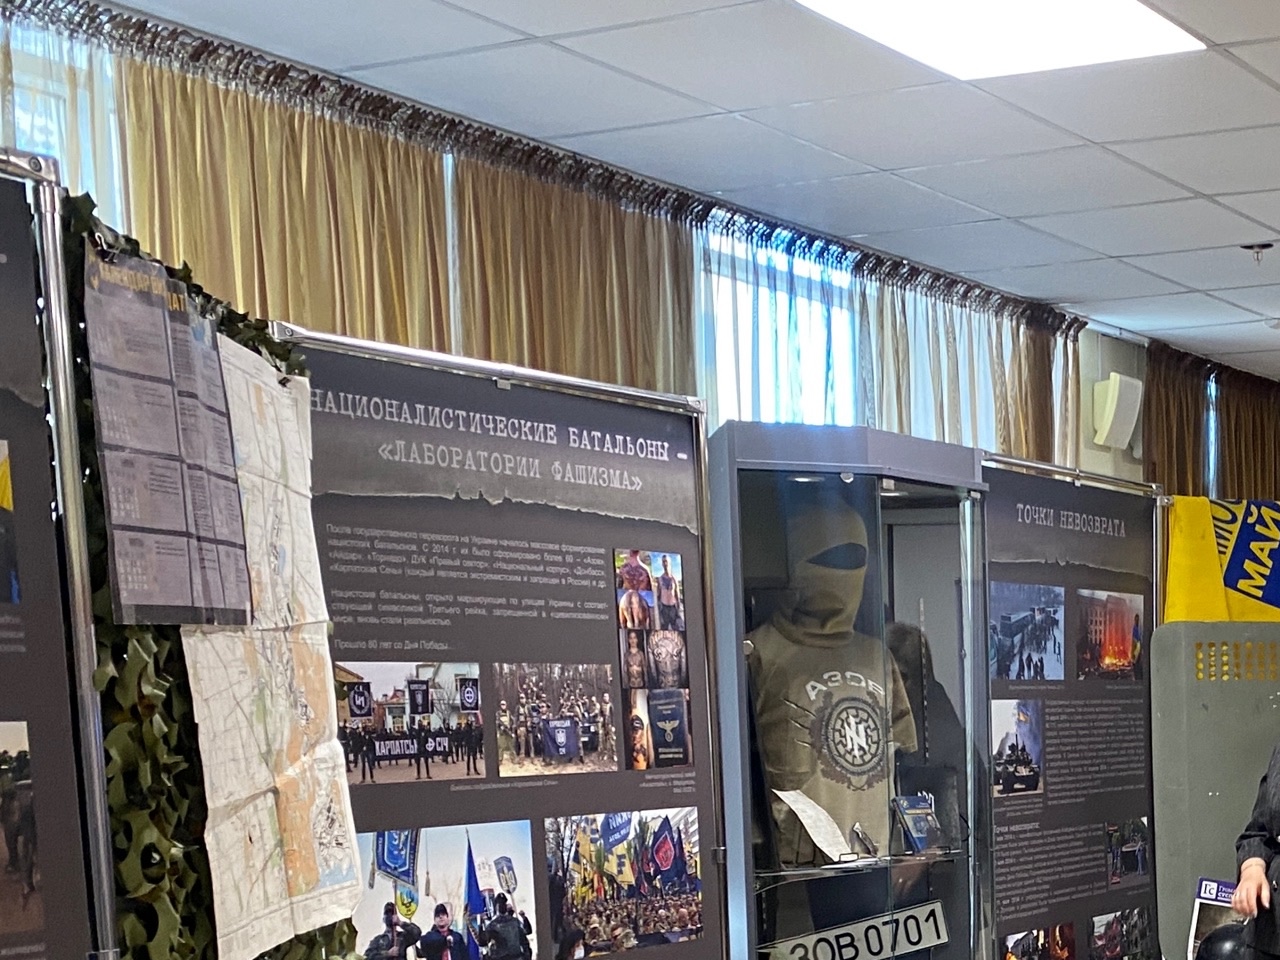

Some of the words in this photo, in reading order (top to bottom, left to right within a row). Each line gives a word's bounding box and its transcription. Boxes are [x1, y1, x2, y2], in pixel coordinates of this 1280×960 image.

[310, 388, 557, 445] НАЦИОНАЛИСТИЧЕСКИЕ
[568, 427, 669, 461] БАТАЛЬОНЫ
[378, 439, 541, 478] «ЛАБОРАТОРИИ
[551, 461, 643, 491] ФАШИЗМА»
[1016, 503, 1054, 527] ТОЧКИ
[1060, 511, 1126, 538] НЕВОЗВРАТА
